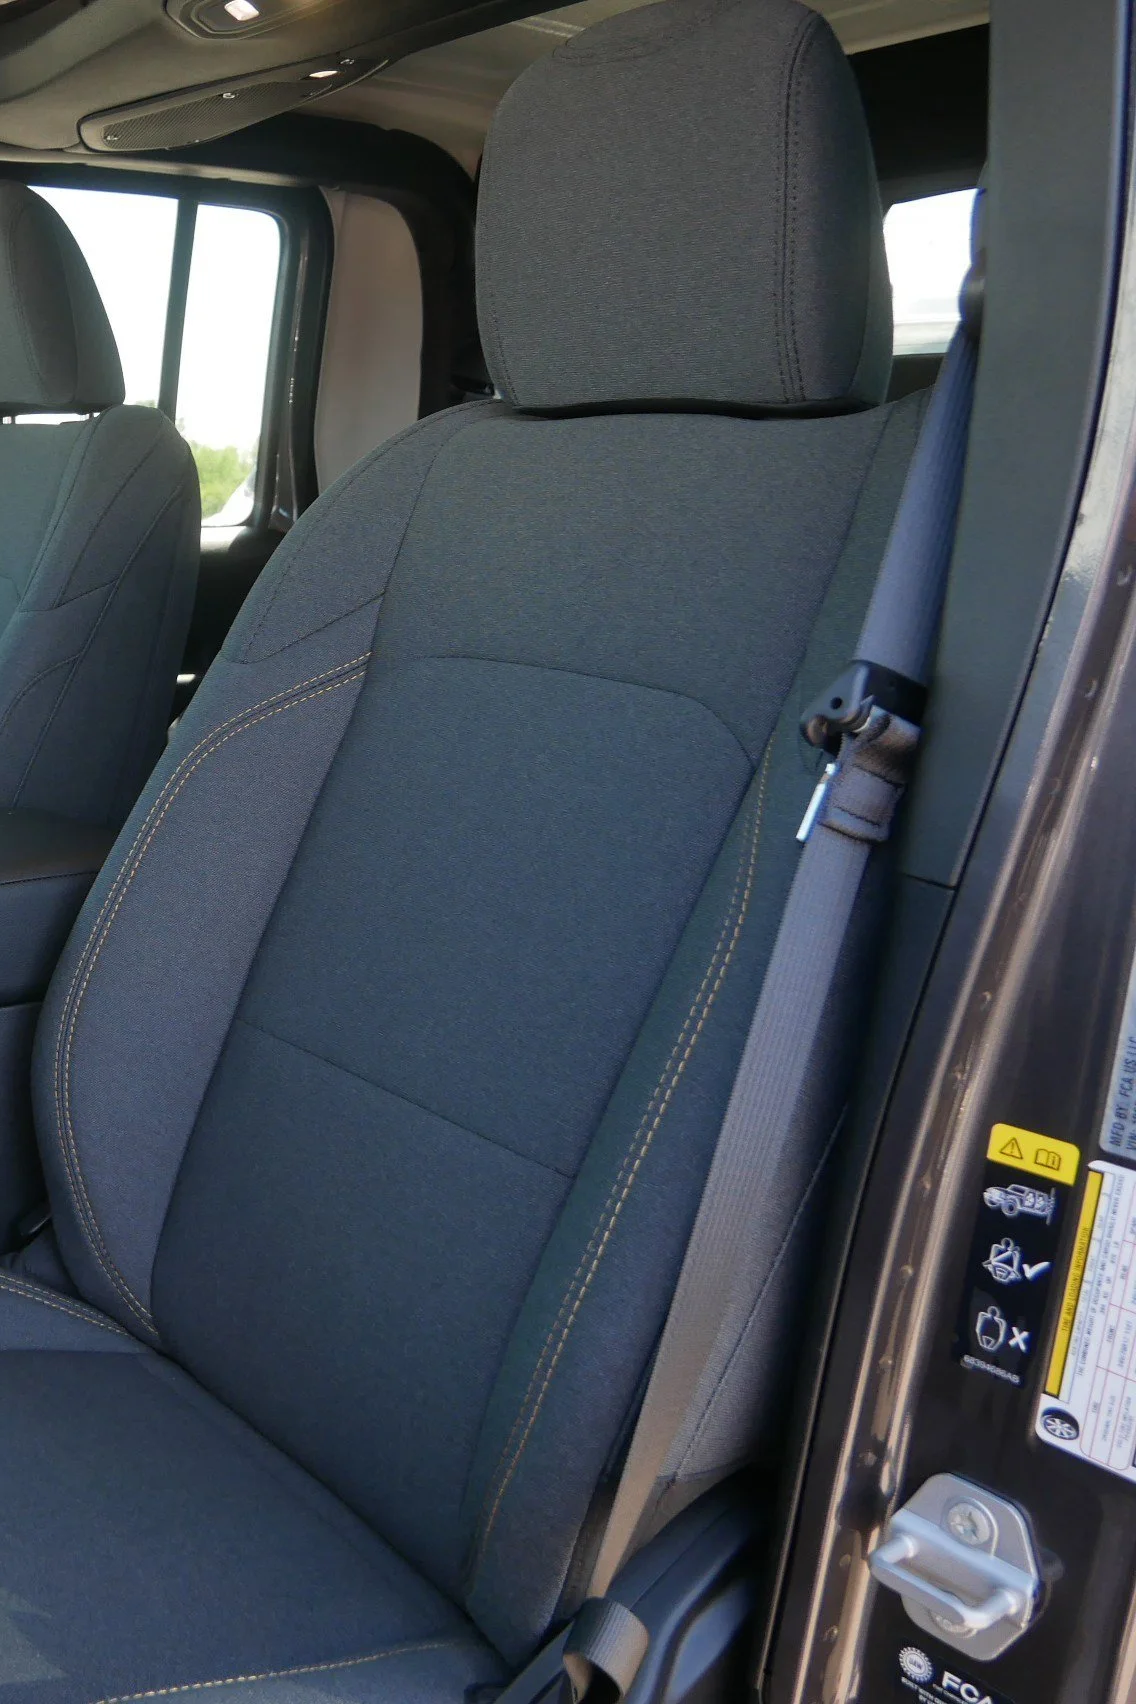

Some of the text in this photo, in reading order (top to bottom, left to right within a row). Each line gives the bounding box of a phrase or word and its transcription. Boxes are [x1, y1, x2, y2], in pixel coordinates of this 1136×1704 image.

[1124, 1058, 1136, 1073] US
[1119, 1078, 1133, 1097] FCA
[1109, 1122, 1125, 1147] MFD
[1073, 1227, 1089, 1271] INFORMATION
